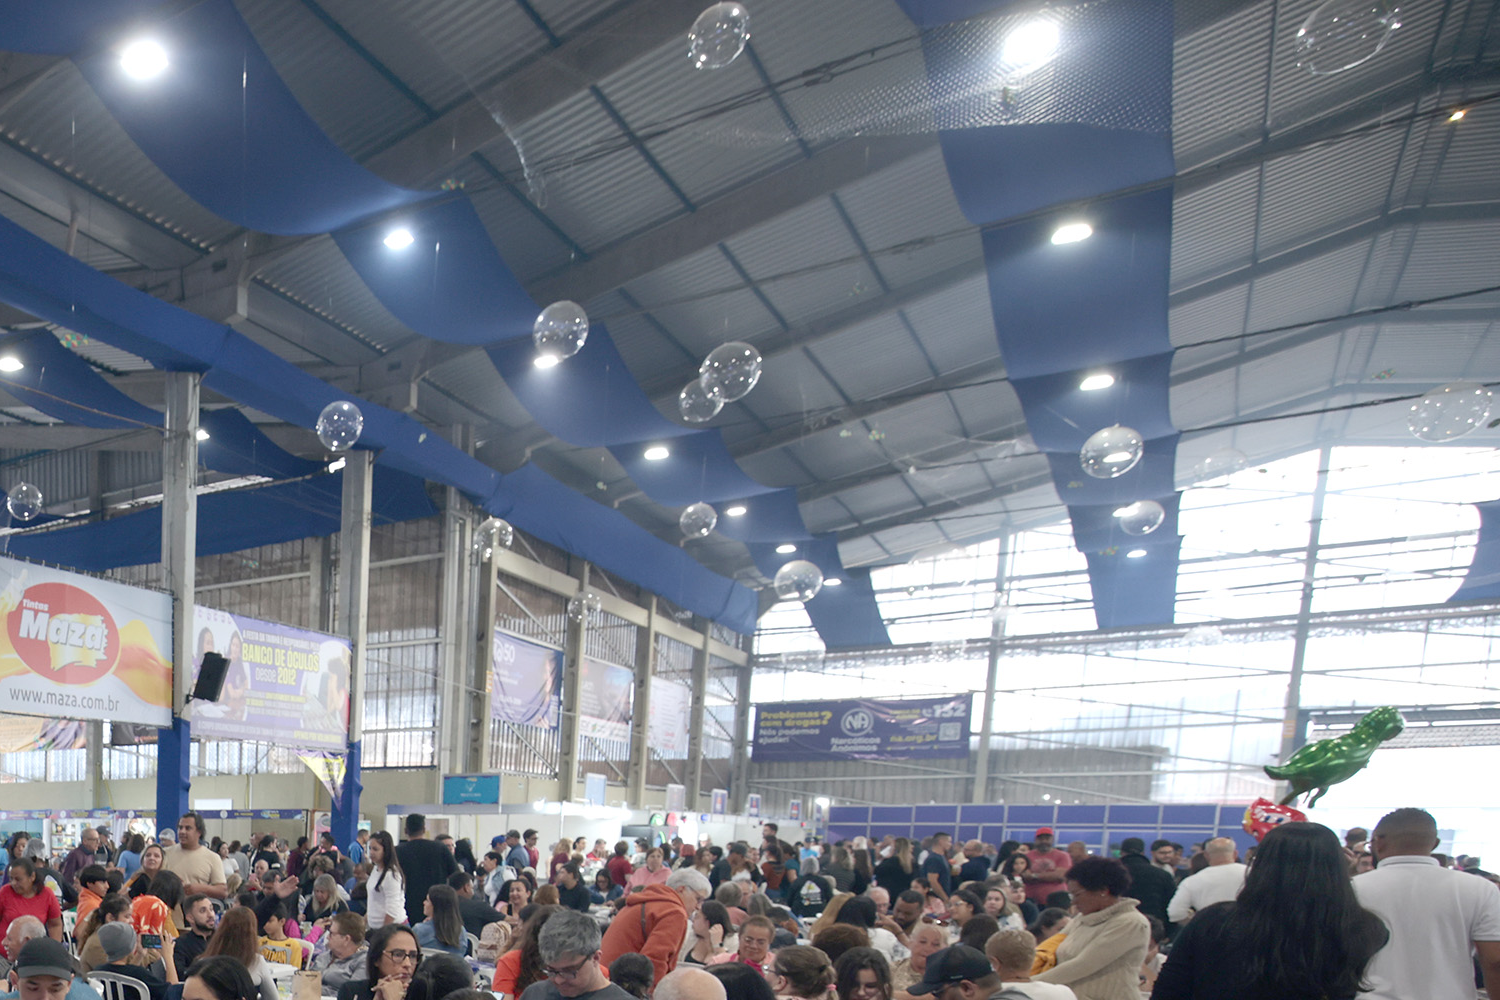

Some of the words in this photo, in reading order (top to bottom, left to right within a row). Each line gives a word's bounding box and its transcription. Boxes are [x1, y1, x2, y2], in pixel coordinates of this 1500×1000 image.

[19, 609, 104, 650] Maza
[242, 643, 273, 665] BANCO
[275, 648, 286, 666] DE
[287, 647, 320, 672] ÓCULOS
[278, 667, 297, 686] 2012
[9, 687, 120, 712] www.maza.com.br
[760, 711, 819, 720] Problemas
[846, 712, 869, 730] NA
